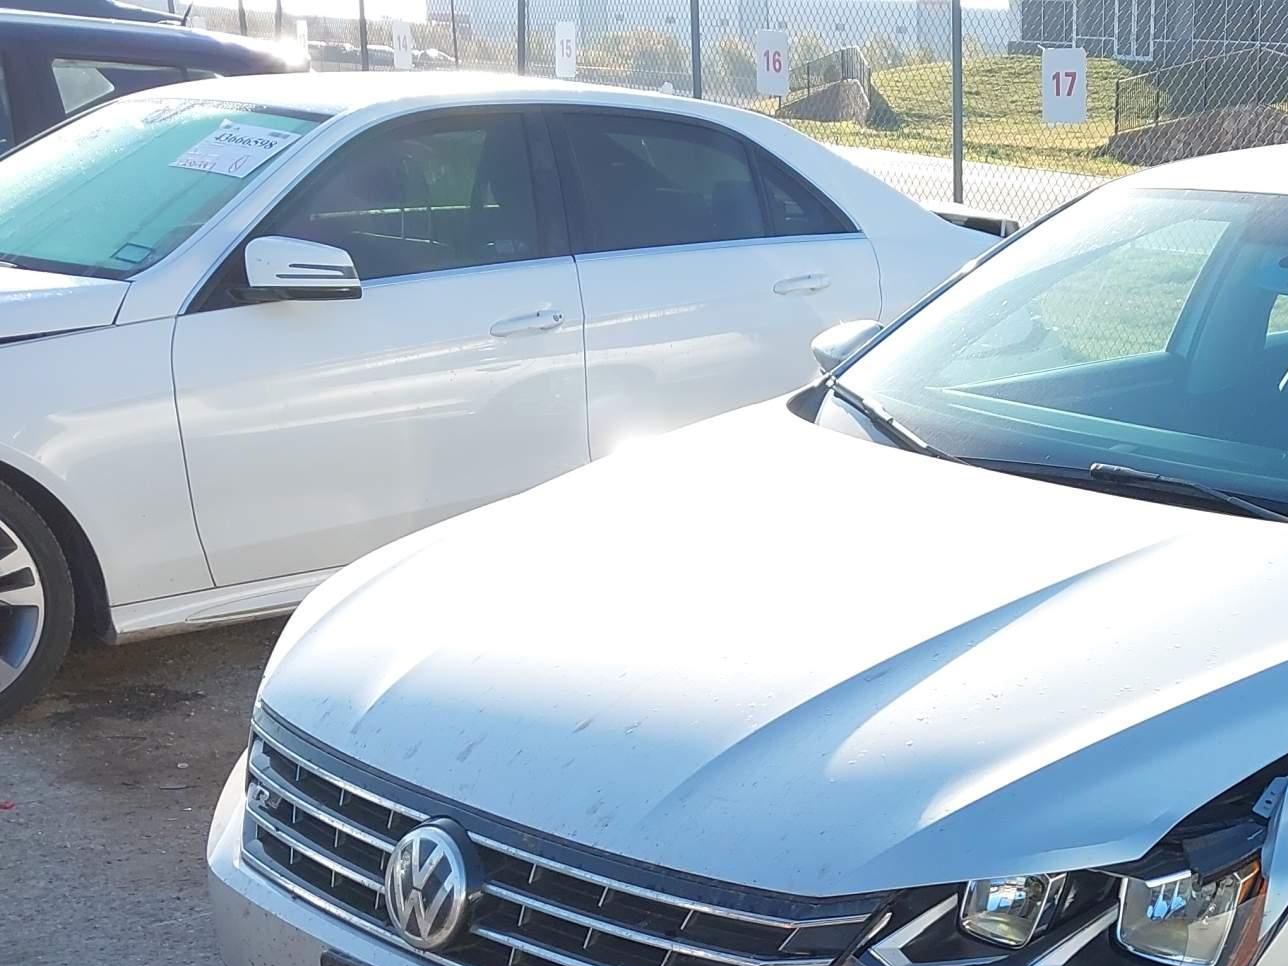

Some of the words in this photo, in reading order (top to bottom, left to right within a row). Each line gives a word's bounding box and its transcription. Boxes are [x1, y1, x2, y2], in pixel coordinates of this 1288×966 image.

[560, 40, 572, 58] 15
[763, 50, 782, 73] 16
[1052, 71, 1077, 97] 17
